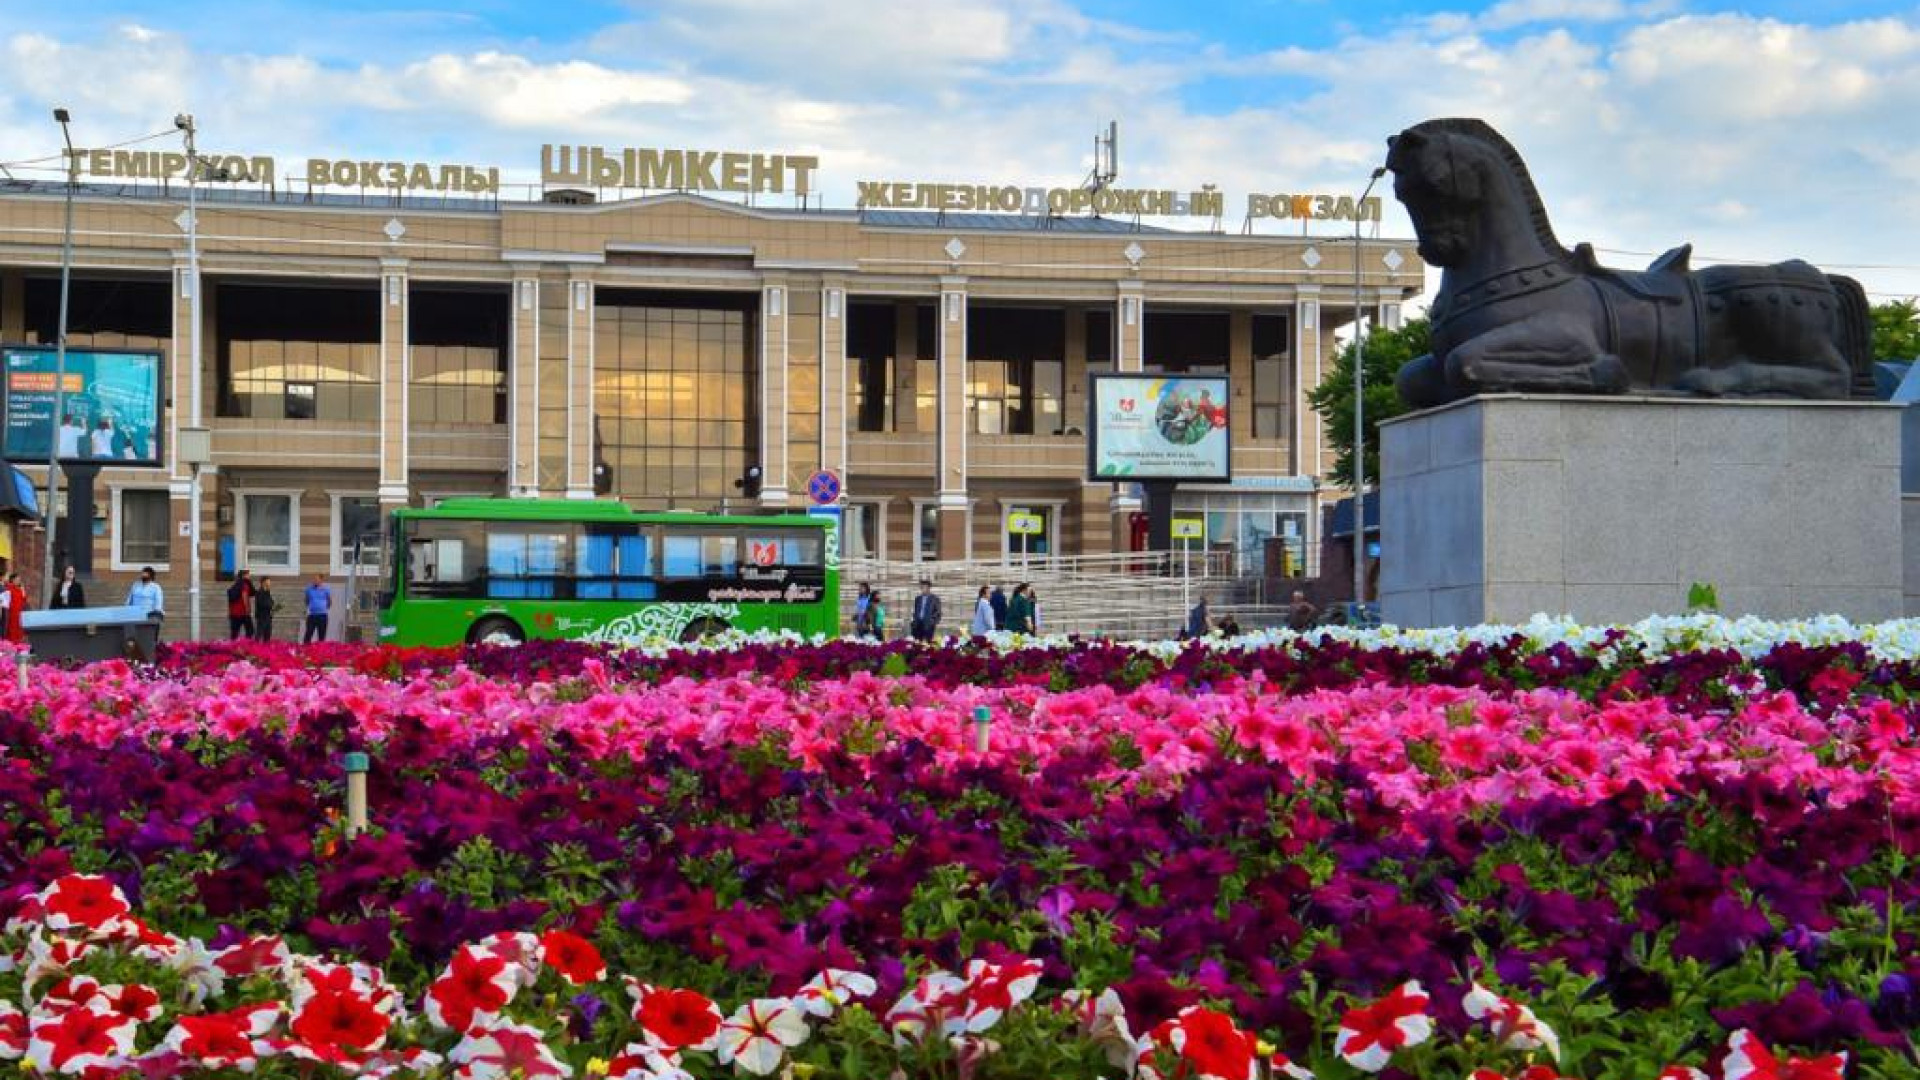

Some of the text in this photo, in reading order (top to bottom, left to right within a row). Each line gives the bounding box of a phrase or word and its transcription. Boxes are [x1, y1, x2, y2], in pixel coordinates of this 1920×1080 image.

[307, 159, 499, 193] ВОКЗАЛЫ
[541, 144, 819, 195] ШЫМКЕНТ
[857, 181, 1381, 221] ЖЕЛЕЗНОДОРОЖНЫЙ ВОКЗАЛ
